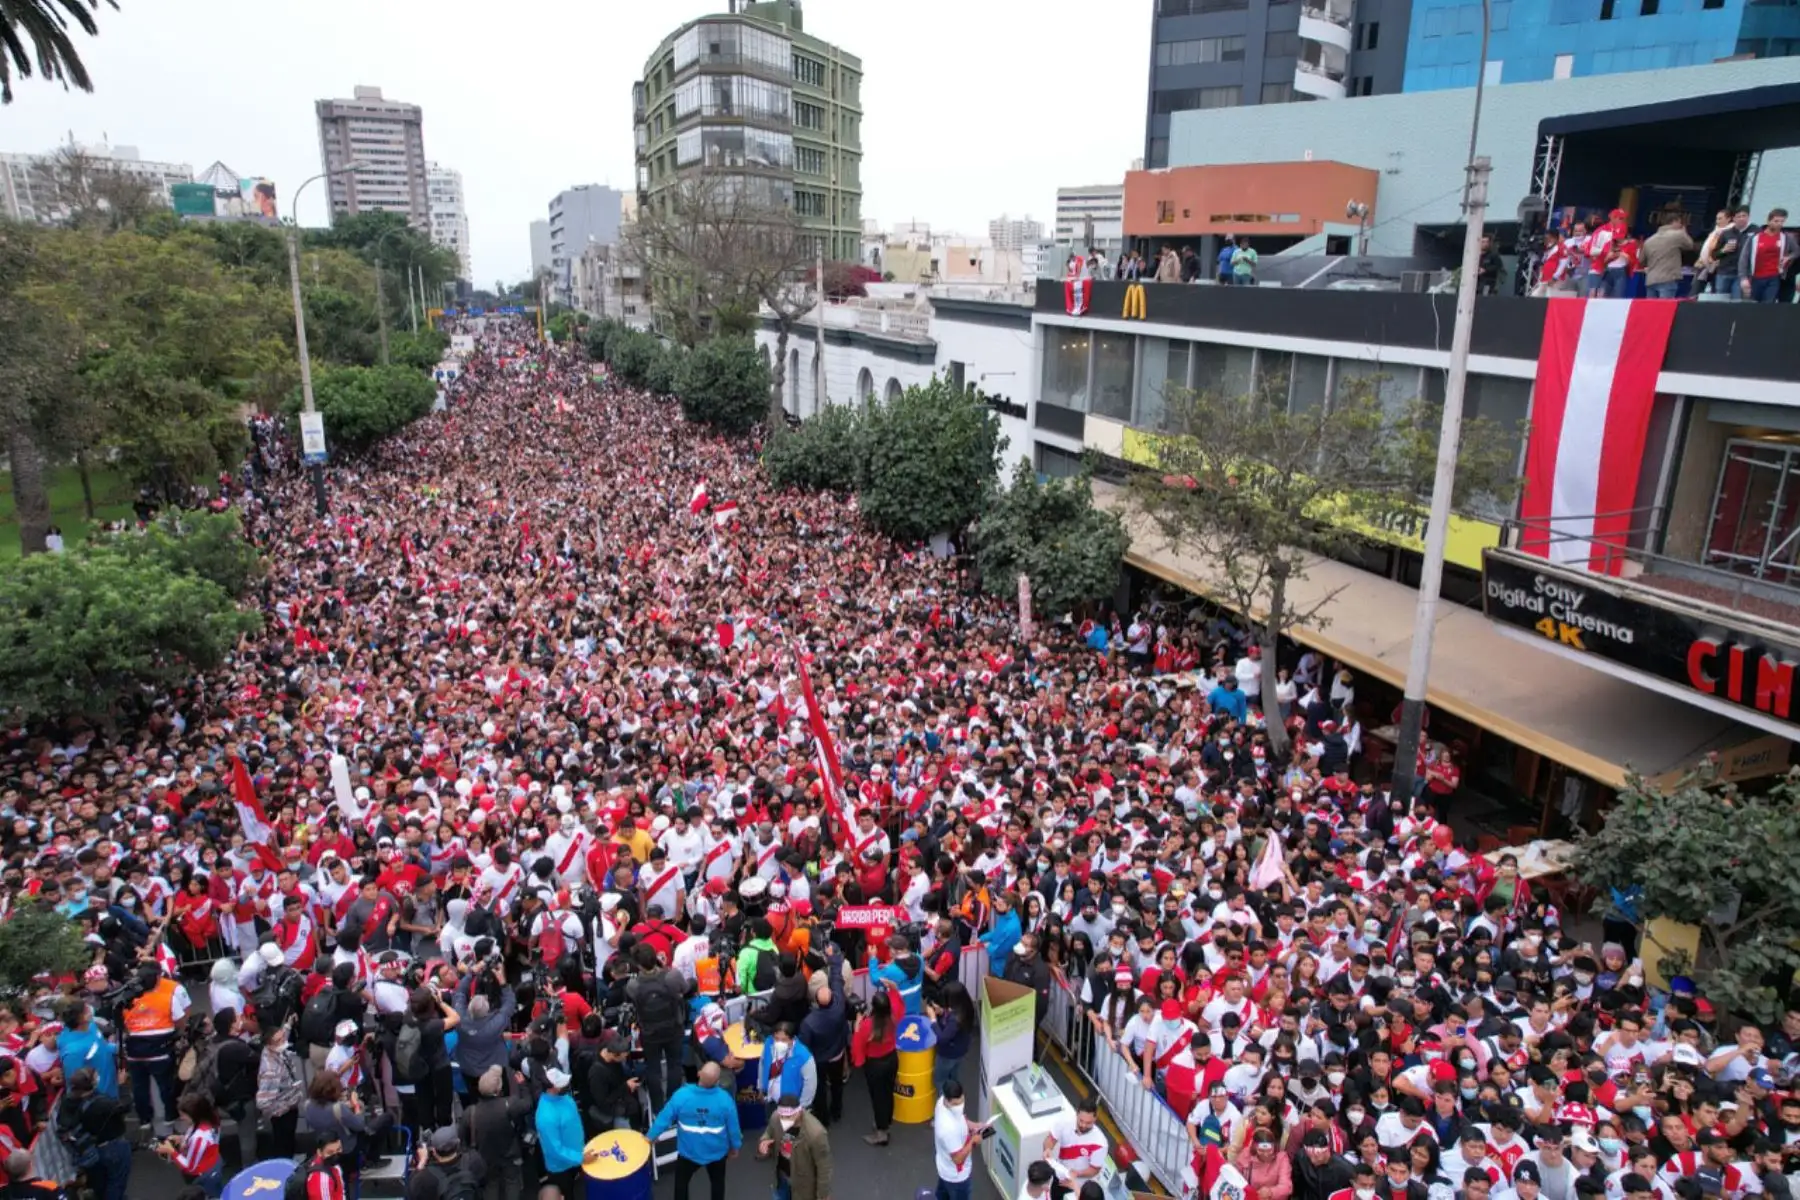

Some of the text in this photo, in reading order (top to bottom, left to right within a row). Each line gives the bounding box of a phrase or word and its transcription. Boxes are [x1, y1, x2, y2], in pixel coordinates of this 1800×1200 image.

[1534, 575, 1585, 610] Sony
[1487, 580, 1634, 644] Digital Cinema
[1535, 617, 1586, 650] 4K
